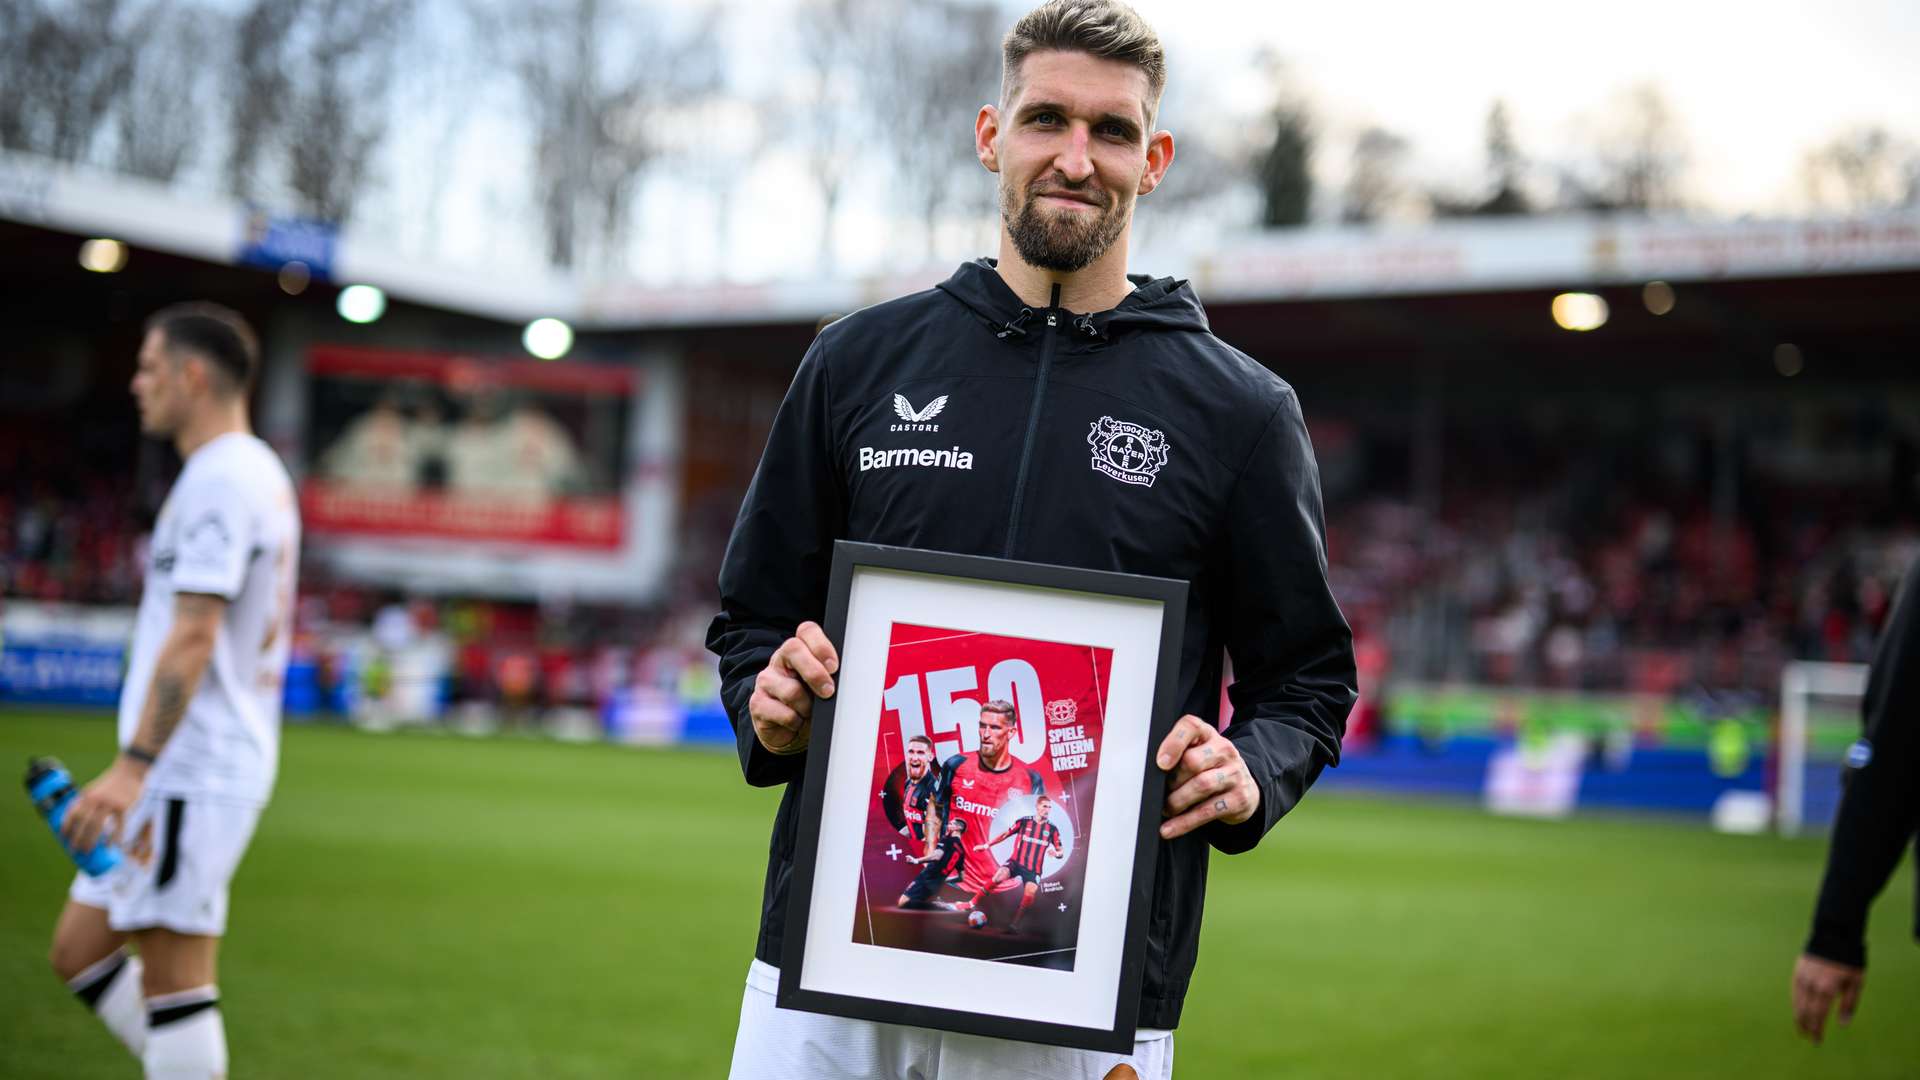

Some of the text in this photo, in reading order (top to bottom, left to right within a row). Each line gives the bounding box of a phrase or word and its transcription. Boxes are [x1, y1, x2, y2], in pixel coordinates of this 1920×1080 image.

[890, 424, 939, 432] CASTORE
[1122, 425, 1142, 436] 1904
[860, 446, 974, 471] Barmenia
[1111, 445, 1144, 460] BAYER
[1097, 460, 1149, 483] Leverkusen
[884, 658, 1047, 766] 150
[1048, 725, 1085, 743] SPIELE
[1050, 738, 1095, 757] UNTERM
[1052, 754, 1088, 772] KREUZ
[955, 796, 999, 818] Barme
